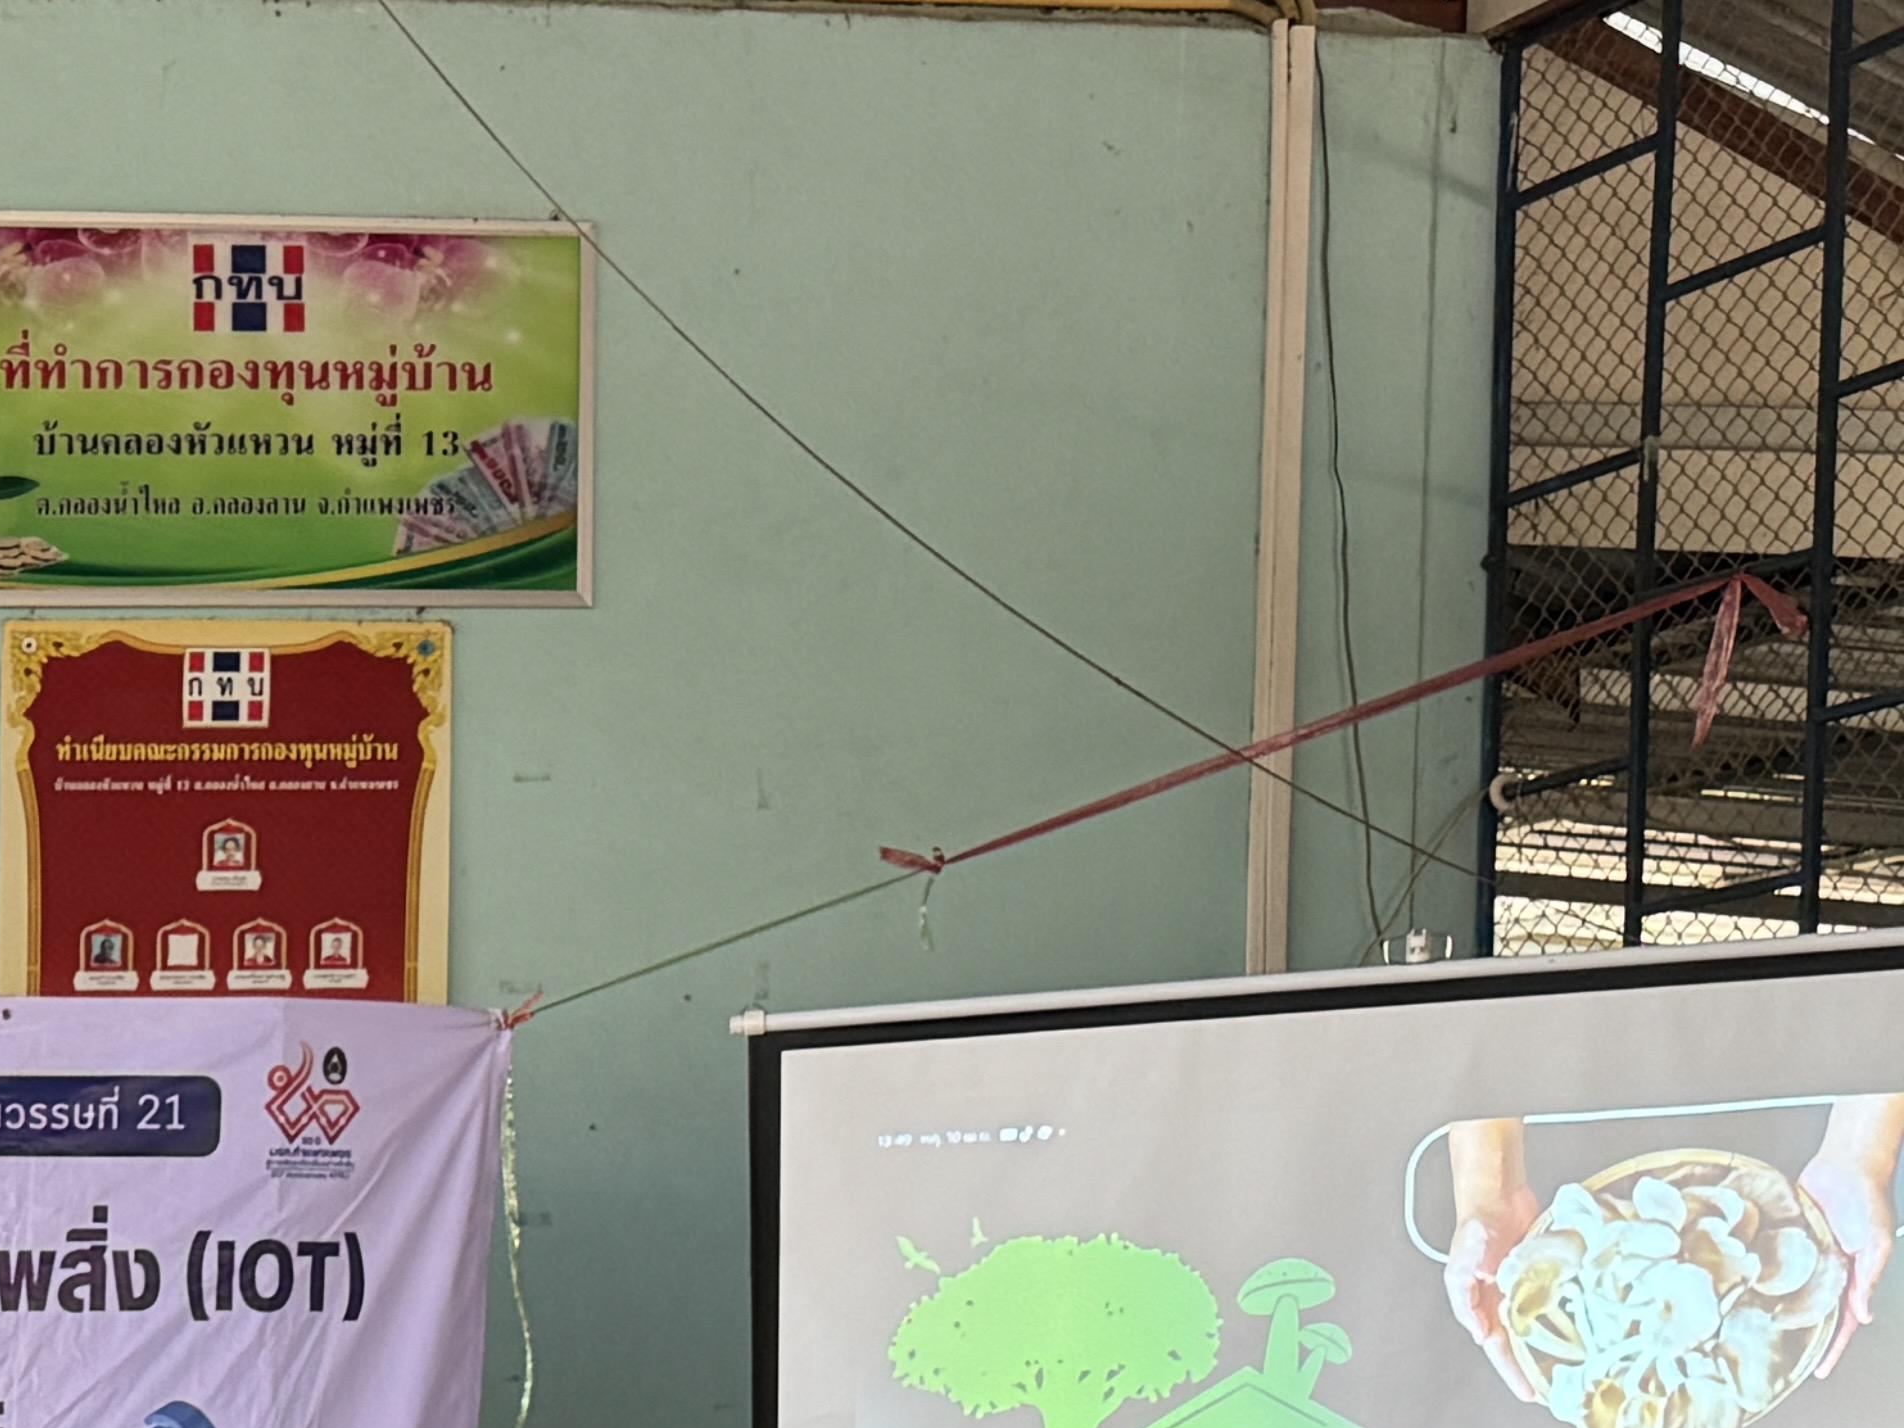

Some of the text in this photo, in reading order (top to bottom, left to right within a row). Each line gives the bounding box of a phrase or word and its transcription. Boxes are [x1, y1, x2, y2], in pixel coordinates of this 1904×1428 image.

[0, 330, 492, 407] ที่ทำการกองทุนหมู่บ้าน
[34, 414, 461, 468] บ้านคลองหัวแหวน หมู่ที่ 13
[56, 735, 398, 768] ทำเนียบคณะกรรมการกองทุนหมู่บ้าน
[137, 1094, 185, 1131] 21
[188, 1231, 367, 1322] (IOT)
